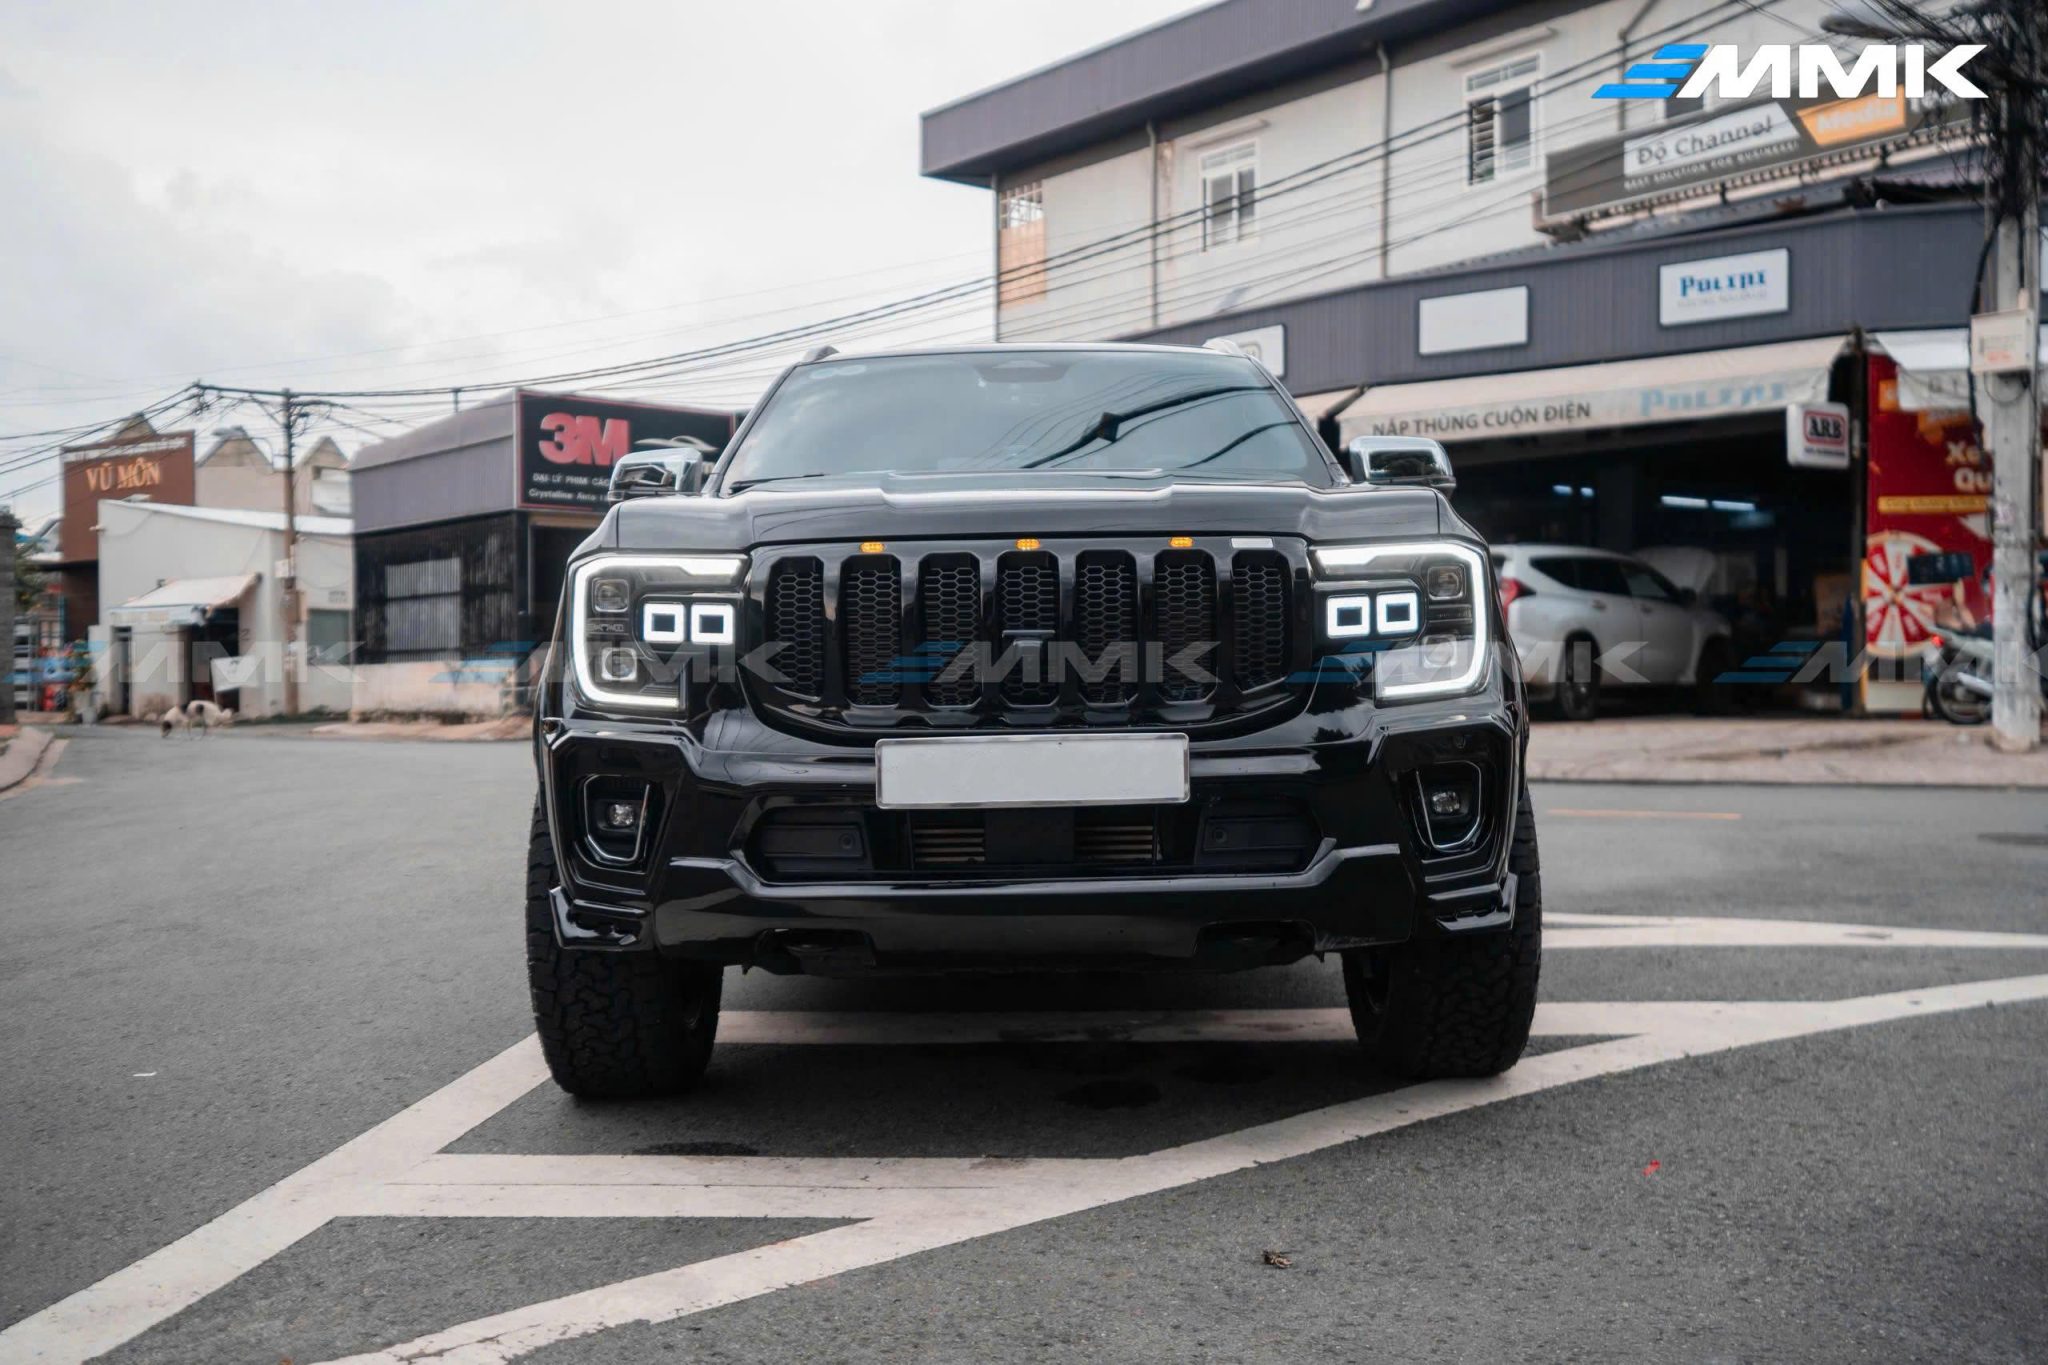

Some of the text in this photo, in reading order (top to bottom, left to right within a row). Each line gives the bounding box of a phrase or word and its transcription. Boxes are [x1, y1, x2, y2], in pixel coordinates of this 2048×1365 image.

[1675, 115, 1773, 156] Channel
[1413, 412, 1479, 434] THÙNG
[1483, 405, 1539, 428] CUỘN
[1543, 400, 1591, 422] ĐIỆN
[1807, 415, 1843, 439] ARB
[538, 412, 630, 466] 3M
[85, 457, 161, 491] VŨ MÔN
